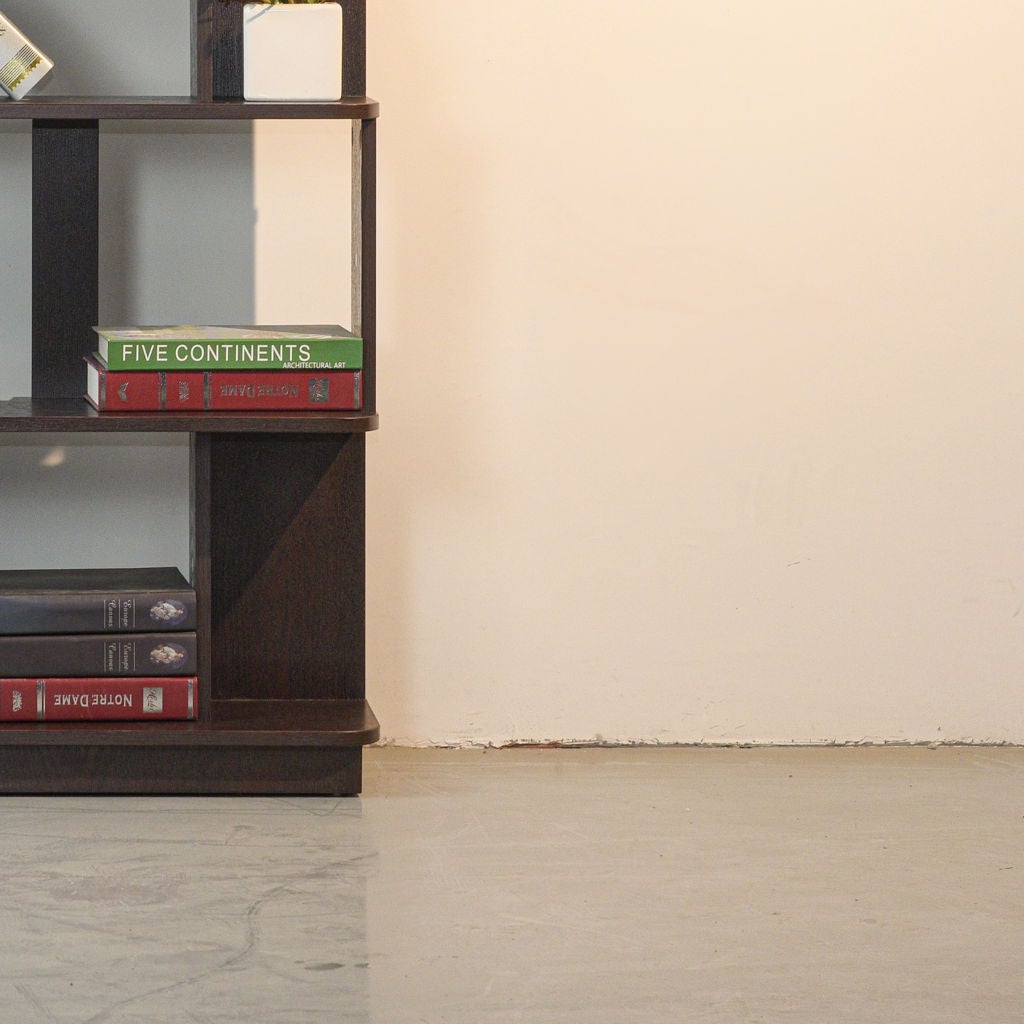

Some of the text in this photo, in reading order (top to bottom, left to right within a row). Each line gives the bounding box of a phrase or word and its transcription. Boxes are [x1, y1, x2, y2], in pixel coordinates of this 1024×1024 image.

[123, 344, 311, 362] FIVE CONTINENTS
[54, 694, 88, 707] DAME
[92, 694, 132, 707] NOTRE
